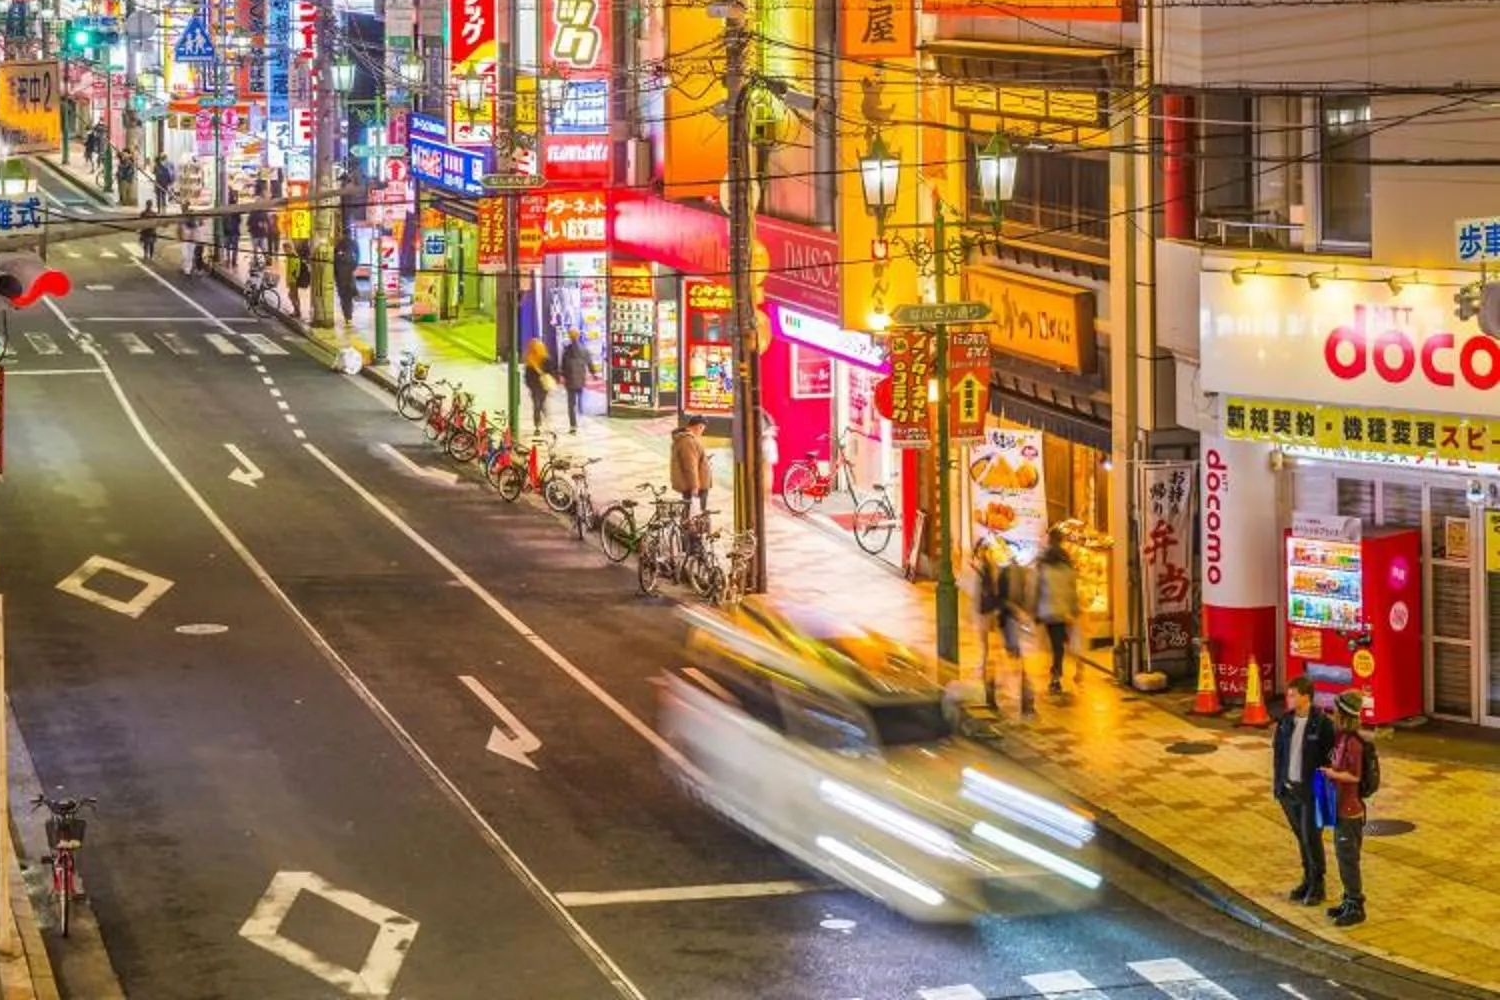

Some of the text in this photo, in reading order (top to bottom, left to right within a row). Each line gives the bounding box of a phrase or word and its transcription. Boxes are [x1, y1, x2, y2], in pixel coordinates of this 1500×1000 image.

[547, 198, 606, 217] ターネット
[1205, 449, 1228, 585] docomo
[1143, 519, 1191, 603] 弁当
